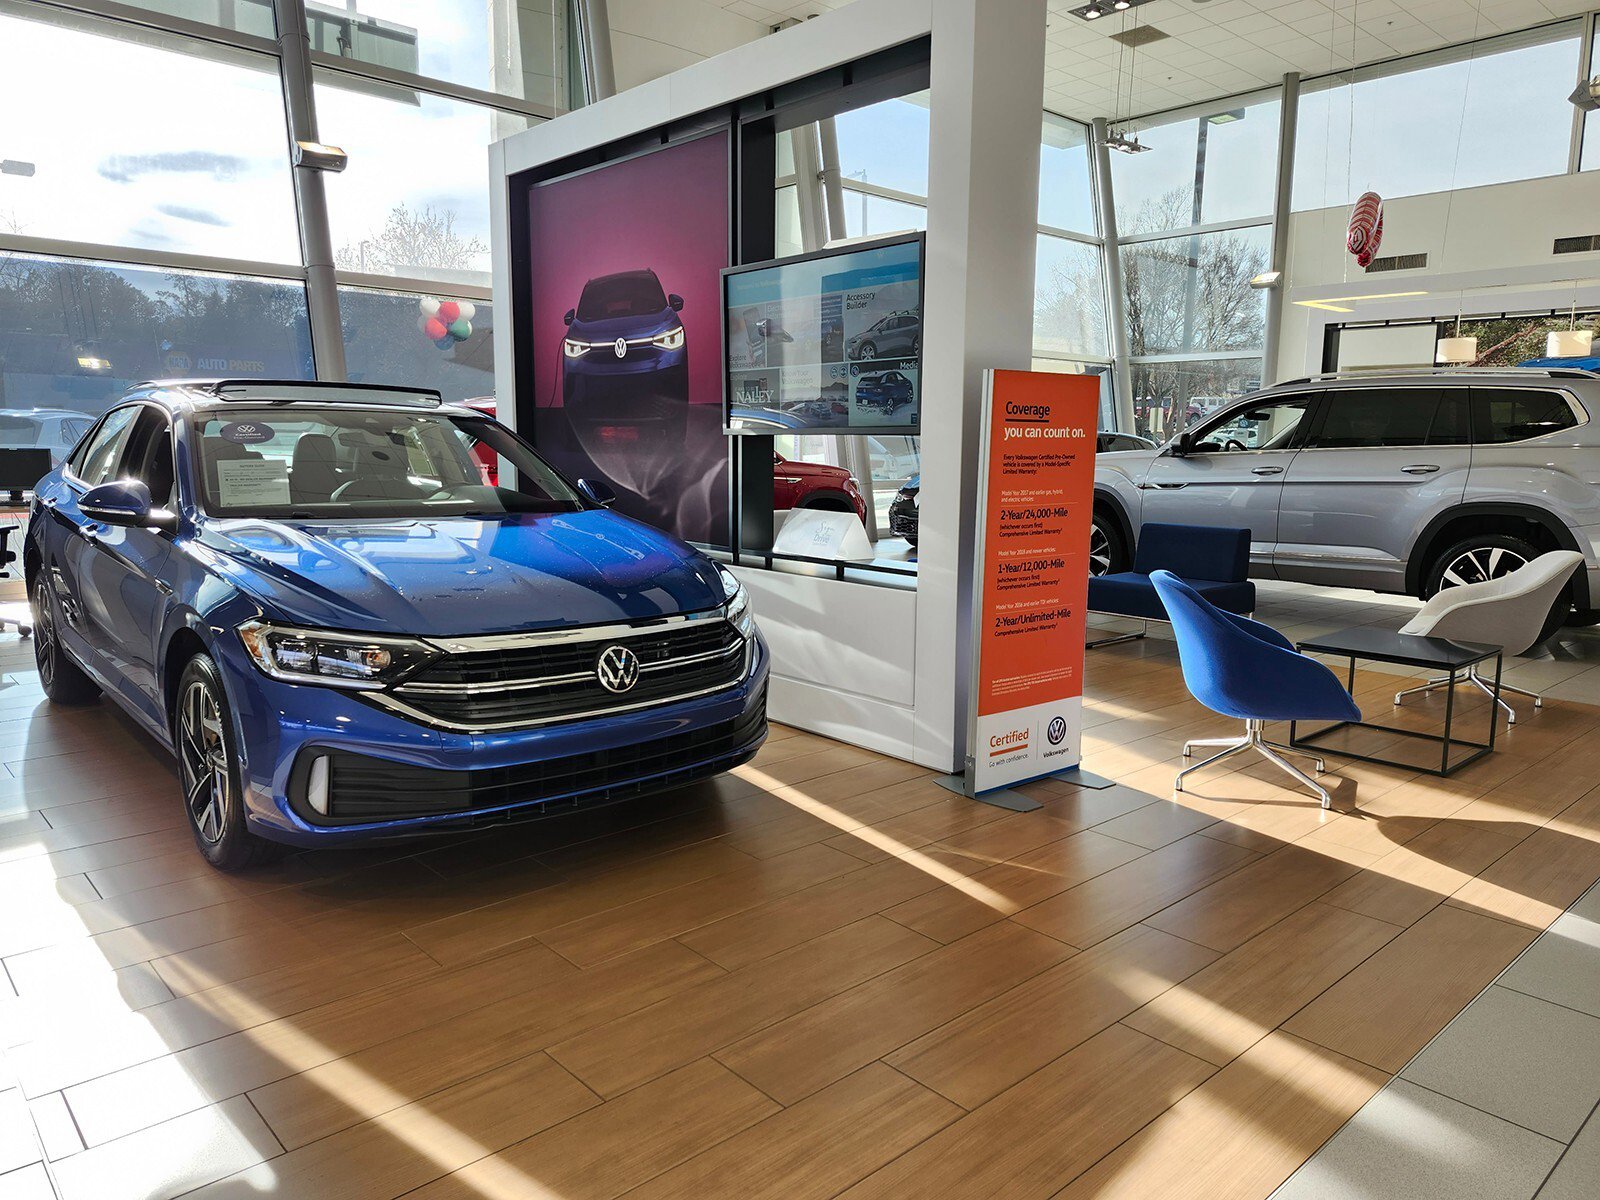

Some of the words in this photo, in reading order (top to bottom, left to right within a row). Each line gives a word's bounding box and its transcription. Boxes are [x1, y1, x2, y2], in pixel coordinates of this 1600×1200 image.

[847, 292, 876, 301] Accessory
[847, 301, 867, 310] Builder
[198, 358, 227, 370] AUTO
[229, 360, 265, 372] PARTS
[736, 386, 774, 403] NALLEY
[1005, 401, 1050, 418] Coverage
[1004, 427, 1022, 440] you
[1025, 428, 1041, 438] can
[1044, 427, 1069, 438] count
[1071, 428, 1085, 438] on.
[1001, 508, 1068, 520] 2-Year/24,000-Mile
[998, 559, 1064, 574] 1-Year/12,000-Mile
[996, 608, 1071, 627] 2-Year/Unlimited-Mile
[994, 629, 1024, 637] Comprehensive
[990, 728, 1029, 747] Certified
[1006, 753, 1029, 763] confidence.
[1043, 747, 1069, 758] Volkswagen
